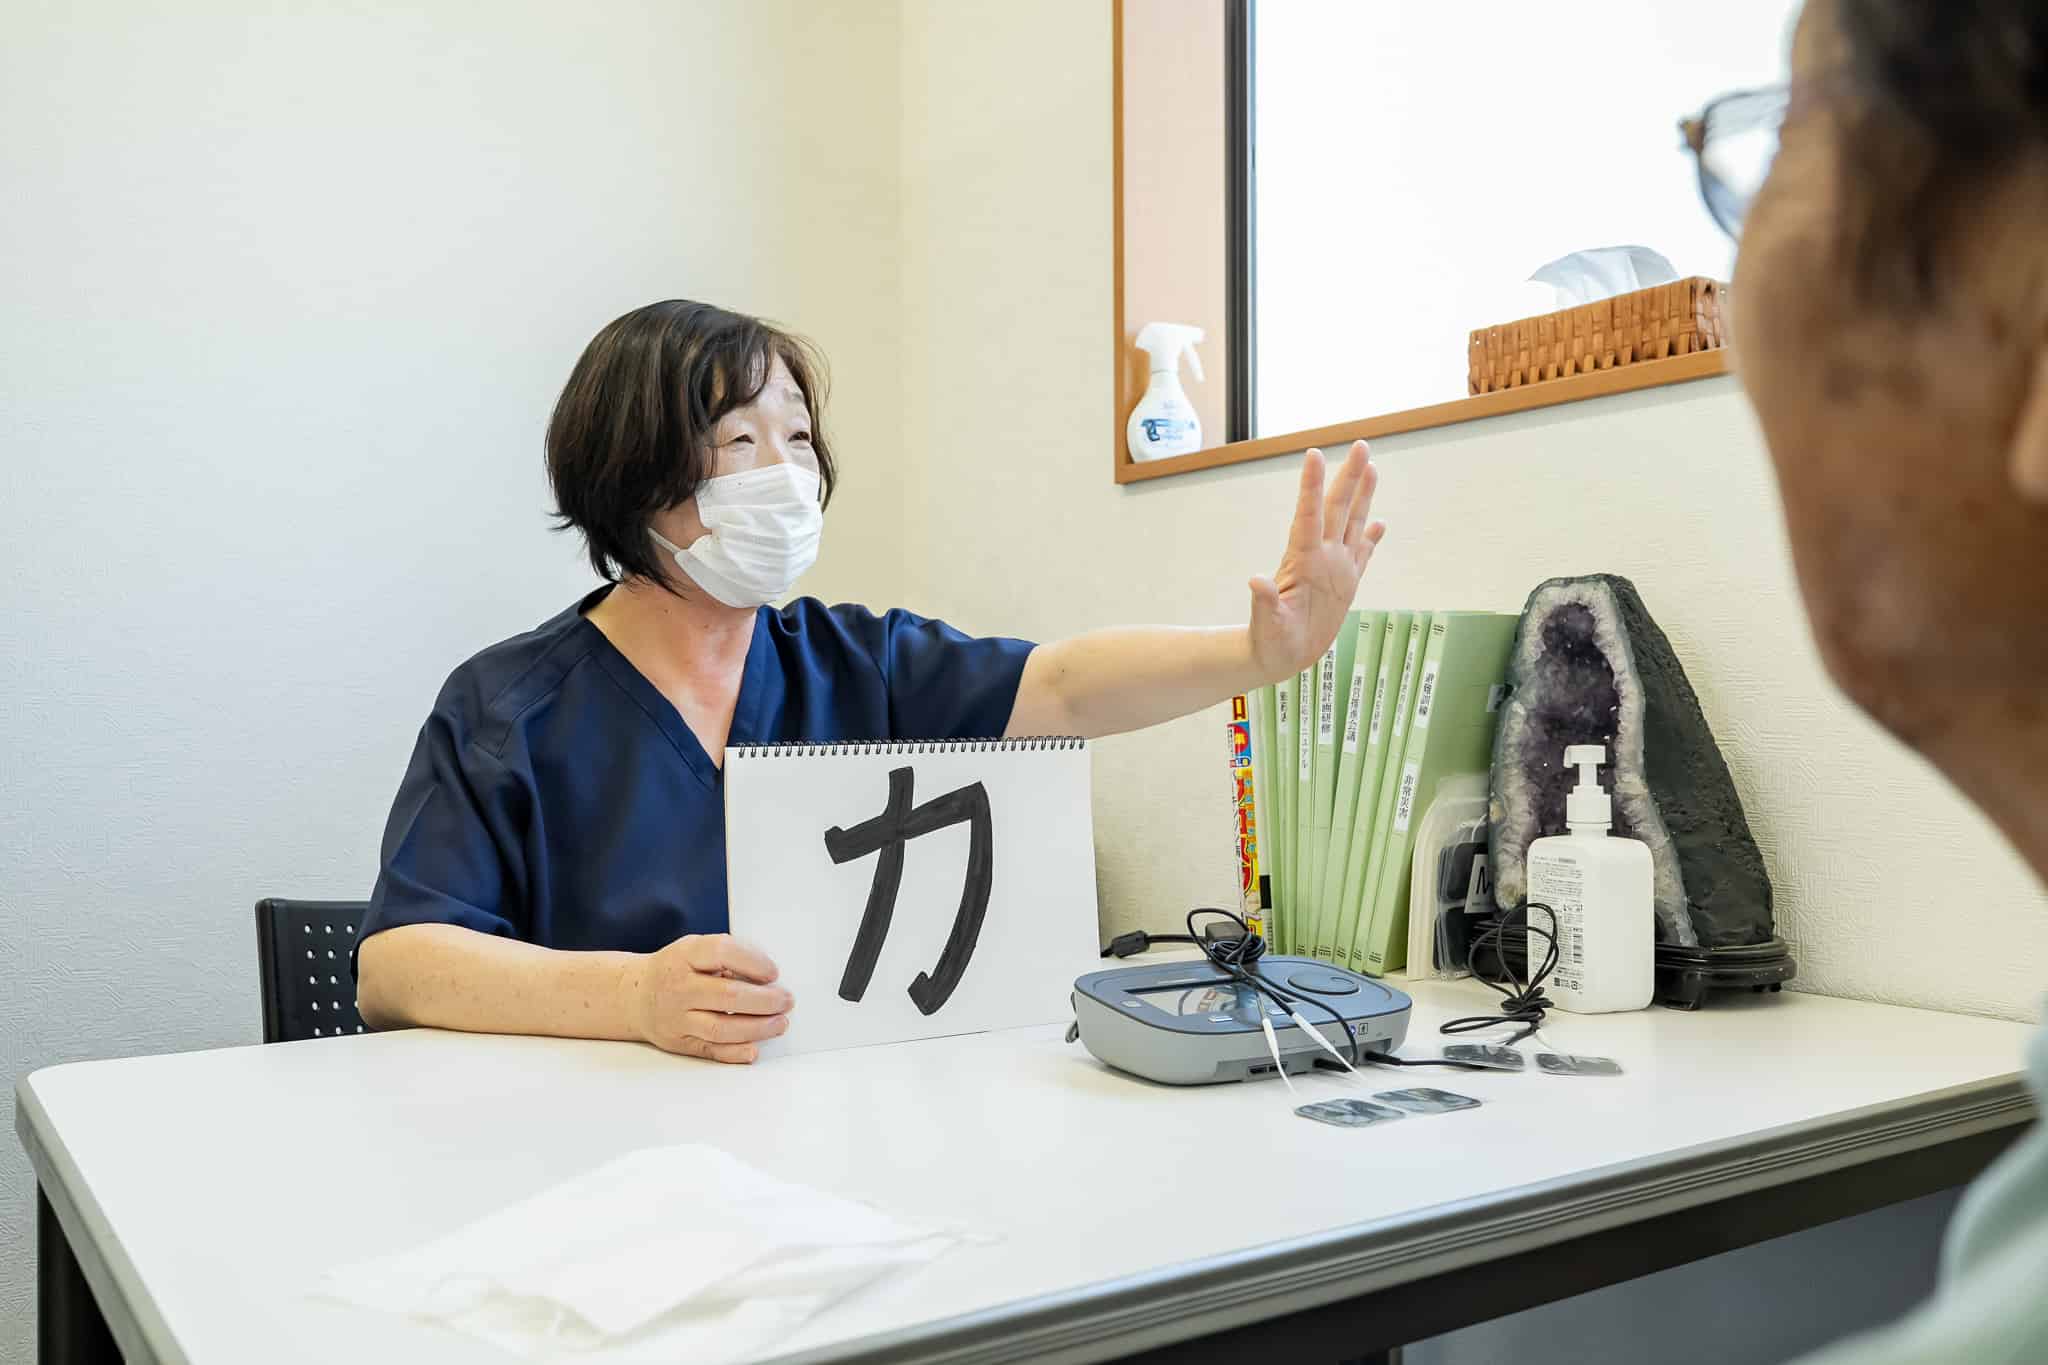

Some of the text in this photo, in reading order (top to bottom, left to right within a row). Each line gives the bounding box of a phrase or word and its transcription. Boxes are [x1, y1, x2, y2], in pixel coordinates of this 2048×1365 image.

[1418, 672, 1435, 716] 避難訓練
[1398, 774, 1415, 819] 非常災害
